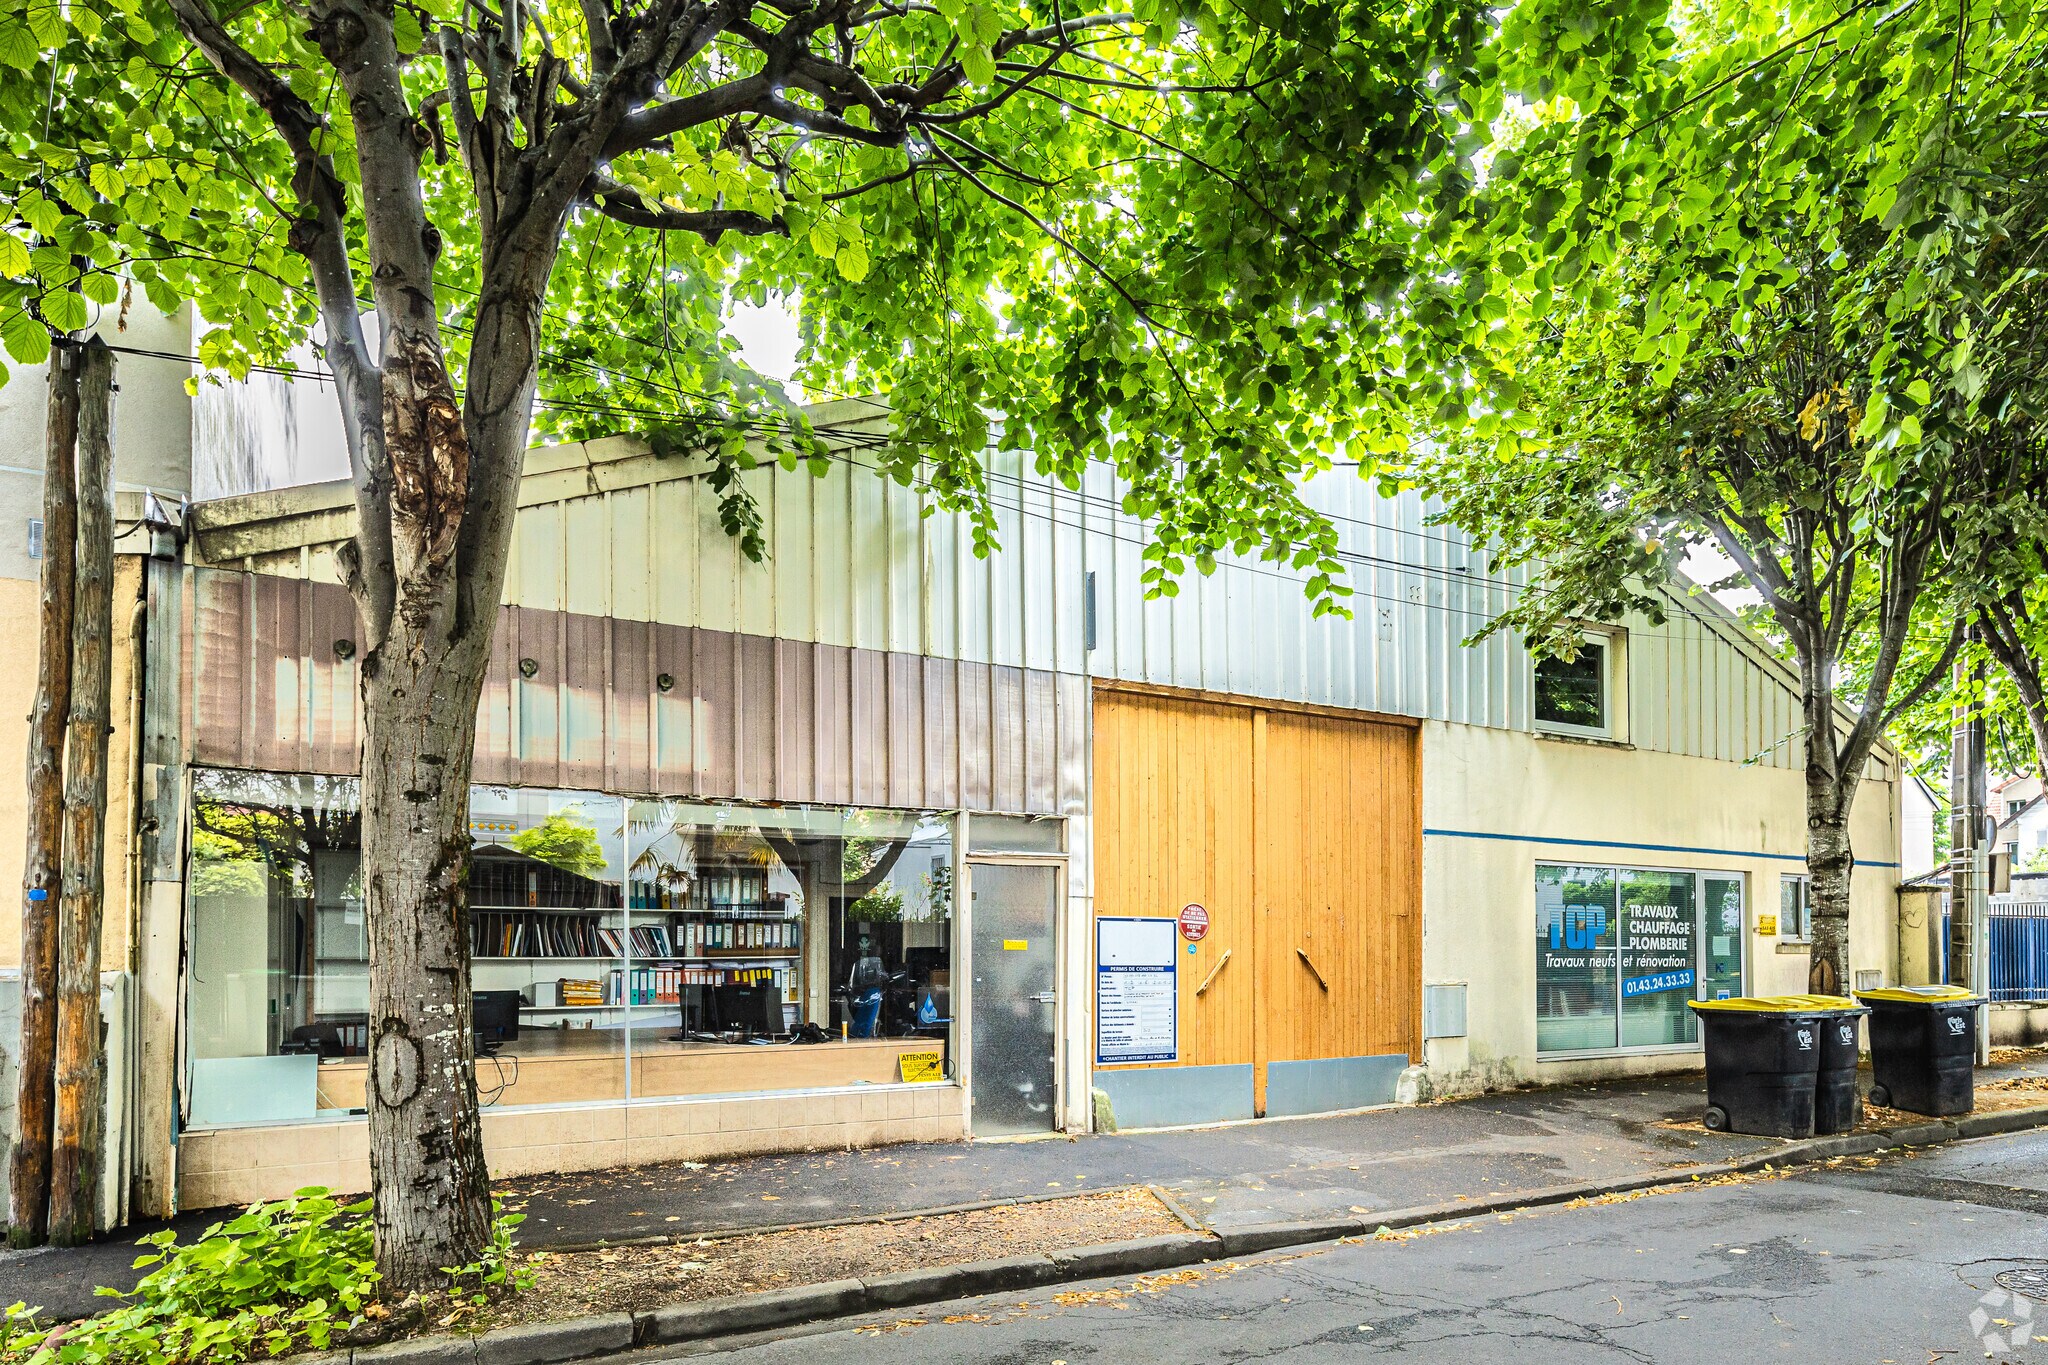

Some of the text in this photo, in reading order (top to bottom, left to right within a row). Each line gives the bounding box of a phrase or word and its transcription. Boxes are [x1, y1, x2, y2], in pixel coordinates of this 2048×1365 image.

[1629, 905, 1678, 918] TRAVAUX
[1544, 903, 1606, 950] TCP
[1629, 921, 1690, 934] CHAUFFAGE
[1629, 937, 1688, 950] PLOMBERIE
[1545, 953, 1686, 968] Travaux neufs et rénovation
[1627, 972, 1690, 994] 01.43.24.33.33
[901, 1053, 938, 1061] ATTENTION
